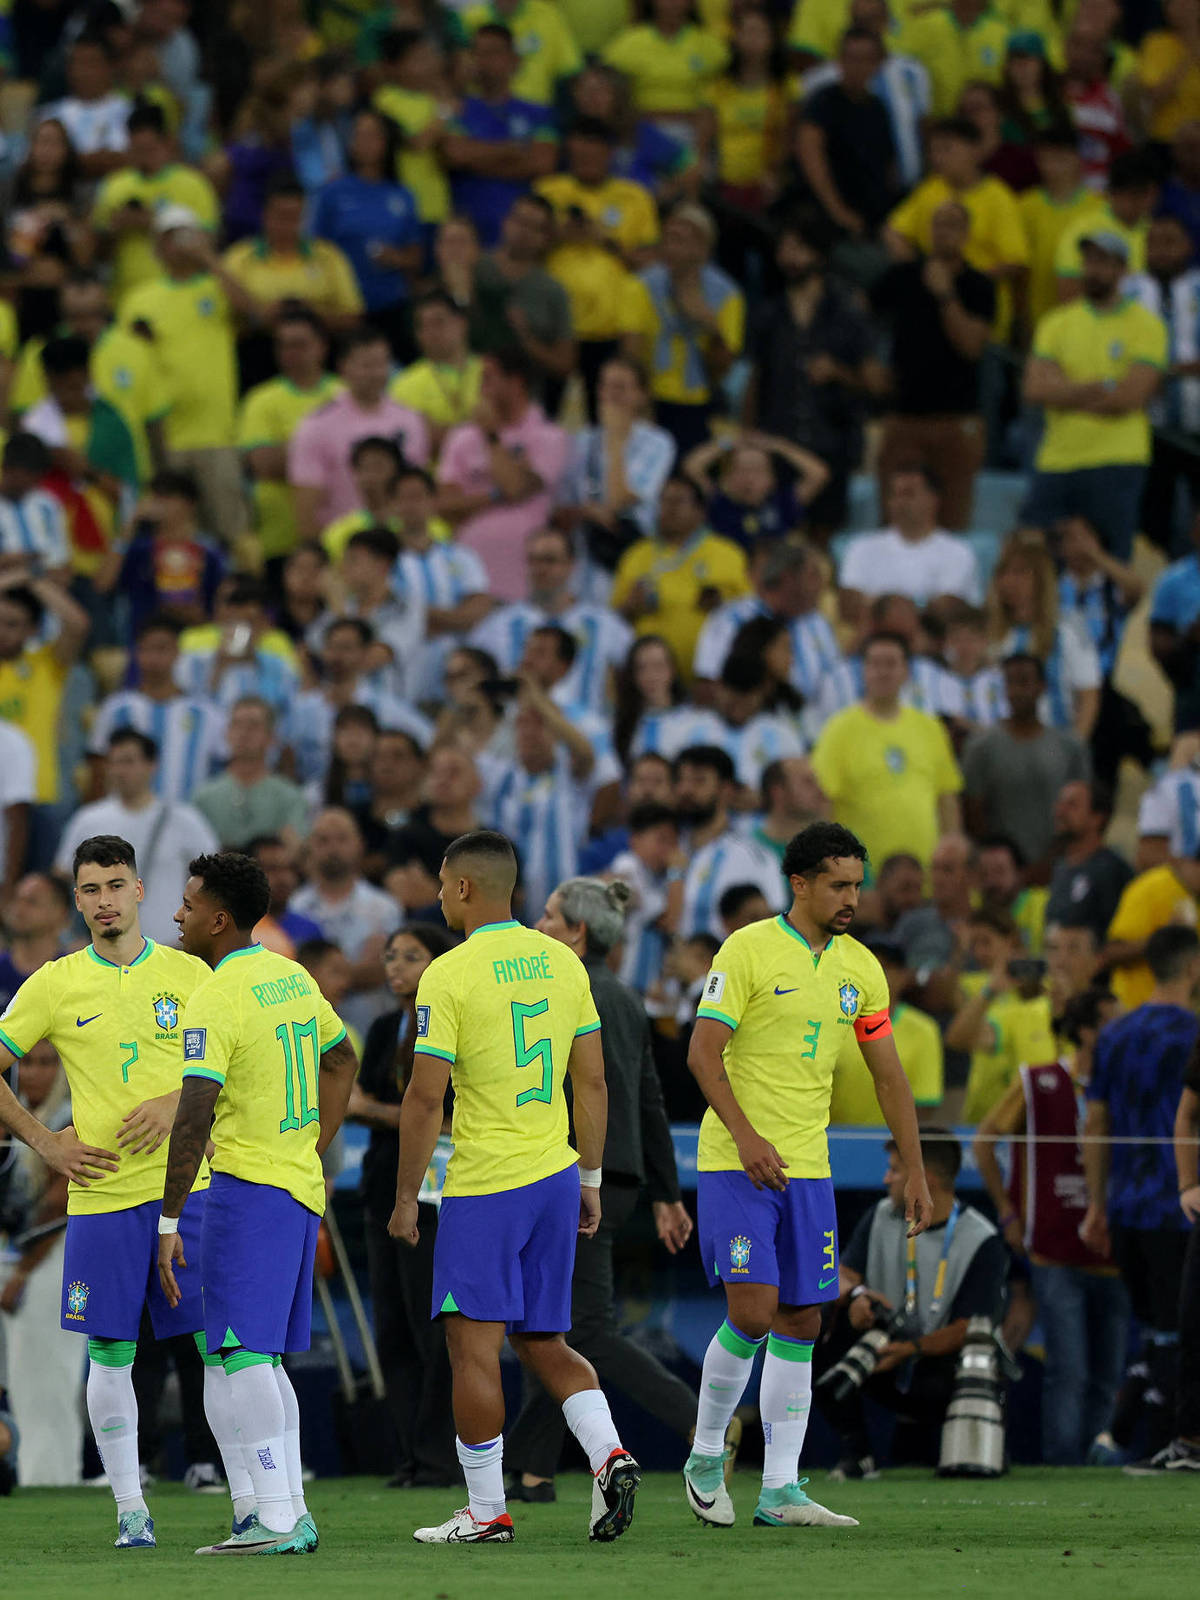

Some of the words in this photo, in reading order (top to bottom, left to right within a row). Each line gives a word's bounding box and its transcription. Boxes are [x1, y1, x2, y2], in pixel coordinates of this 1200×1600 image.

[492, 951, 554, 984] ANDRÉ
[251, 973, 312, 1008] RODRYGO
[511, 998, 553, 1107] 5
[801, 1019, 822, 1060] 3
[119, 1041, 139, 1084] 7
[275, 1016, 320, 1134] 10
[822, 1229, 834, 1271] 3
